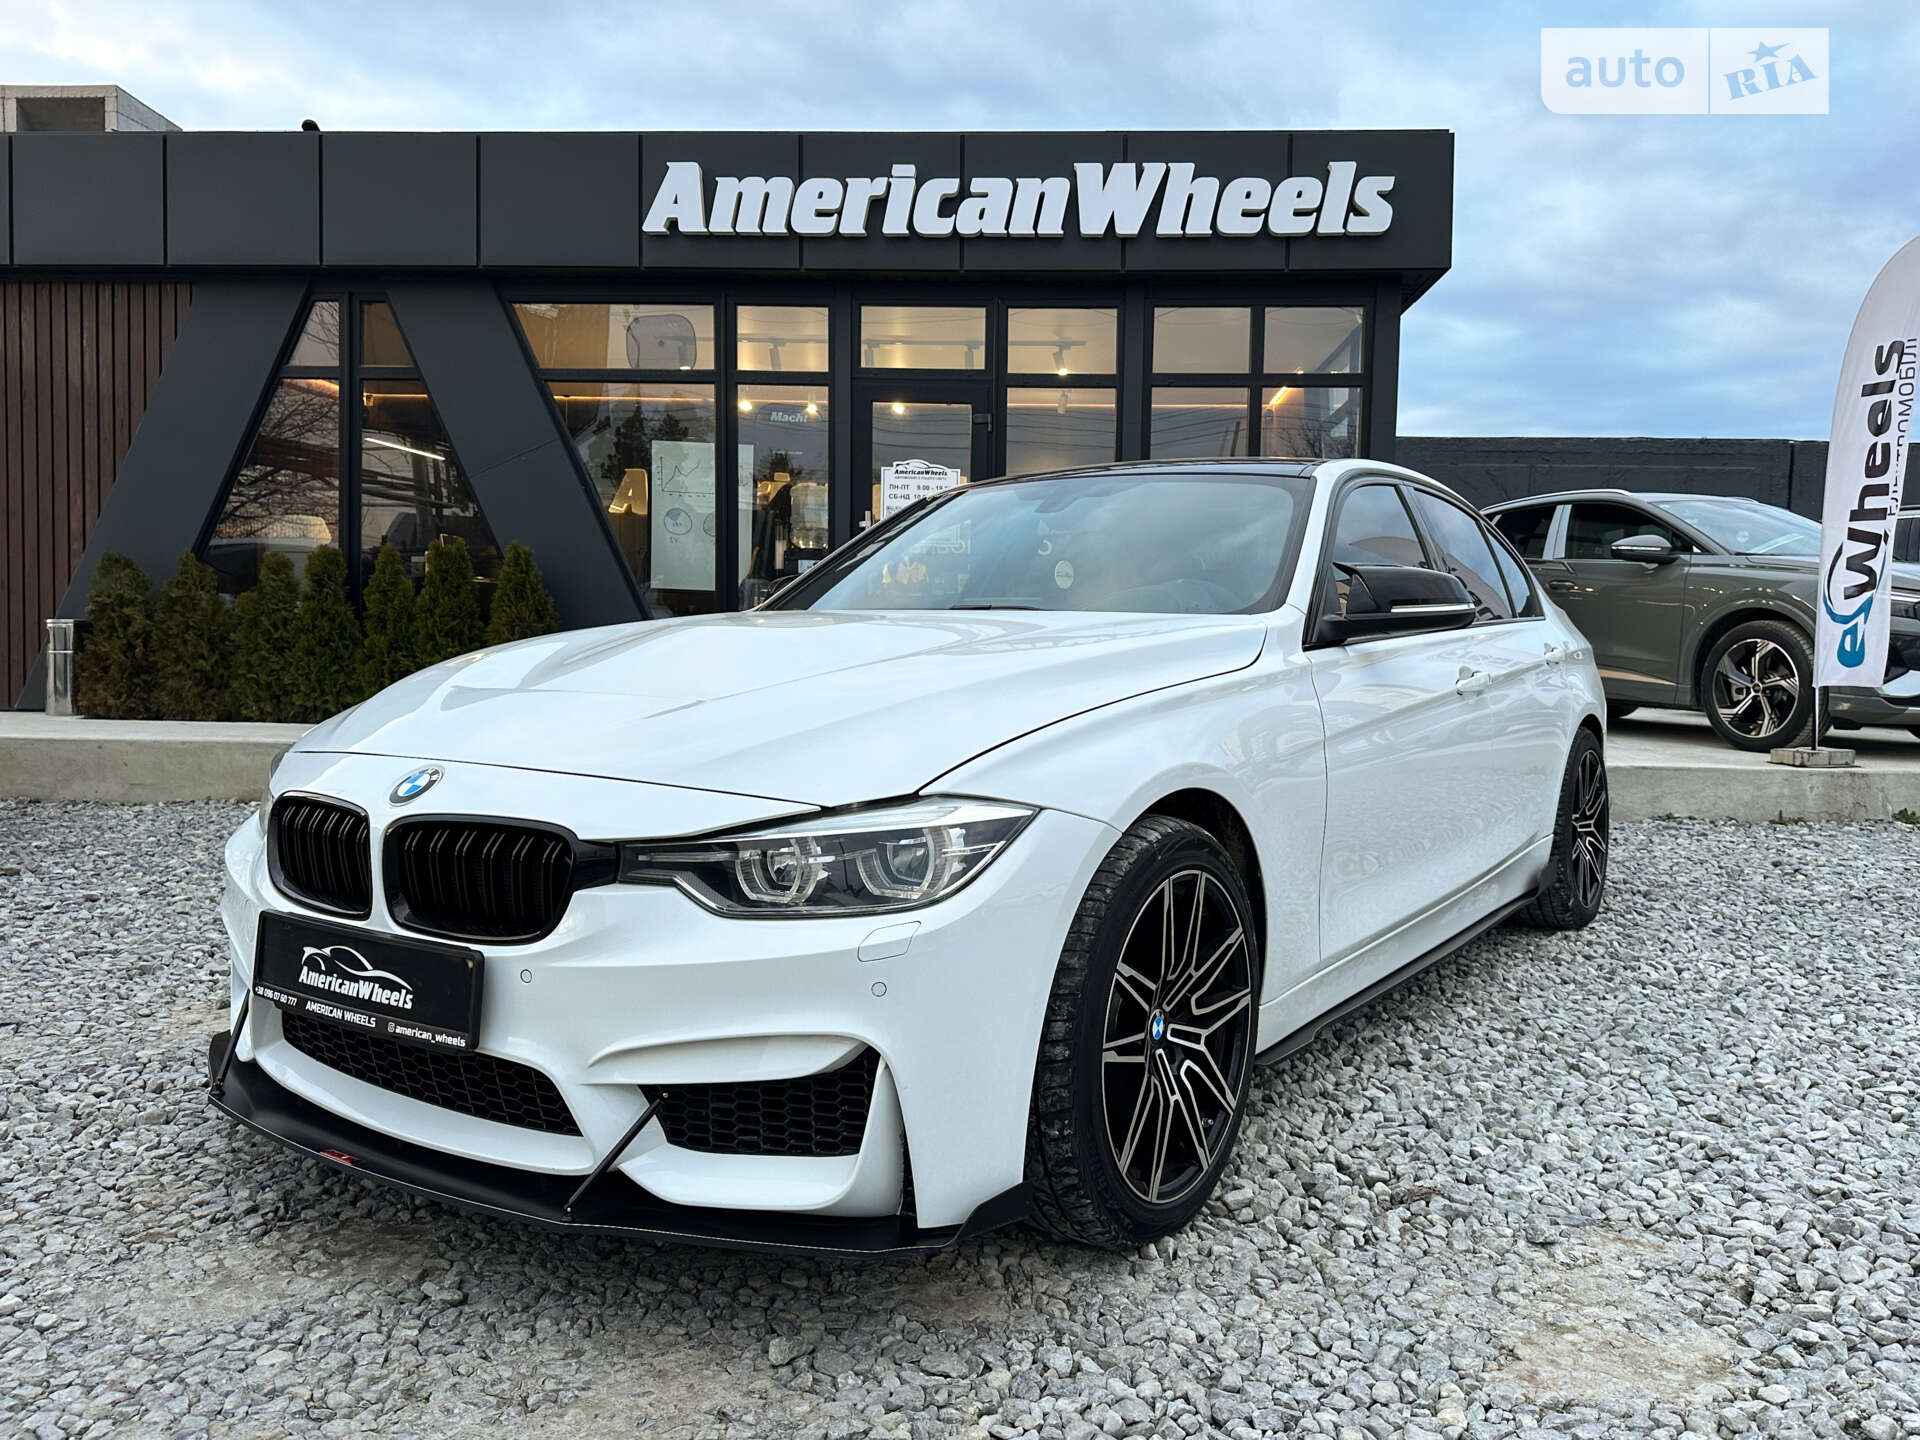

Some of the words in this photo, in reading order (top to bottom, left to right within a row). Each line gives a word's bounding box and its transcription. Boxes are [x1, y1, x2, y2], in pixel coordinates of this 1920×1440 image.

[641, 160, 1396, 239] AmericanWheels
[287, 996, 297, 1007] 777
[298, 965, 412, 1010] AmericanWheels
[305, 1000, 343, 1019] AMERICAN
[344, 1010, 376, 1028] WHEELS
[395, 1024, 466, 1047] american_wheels
